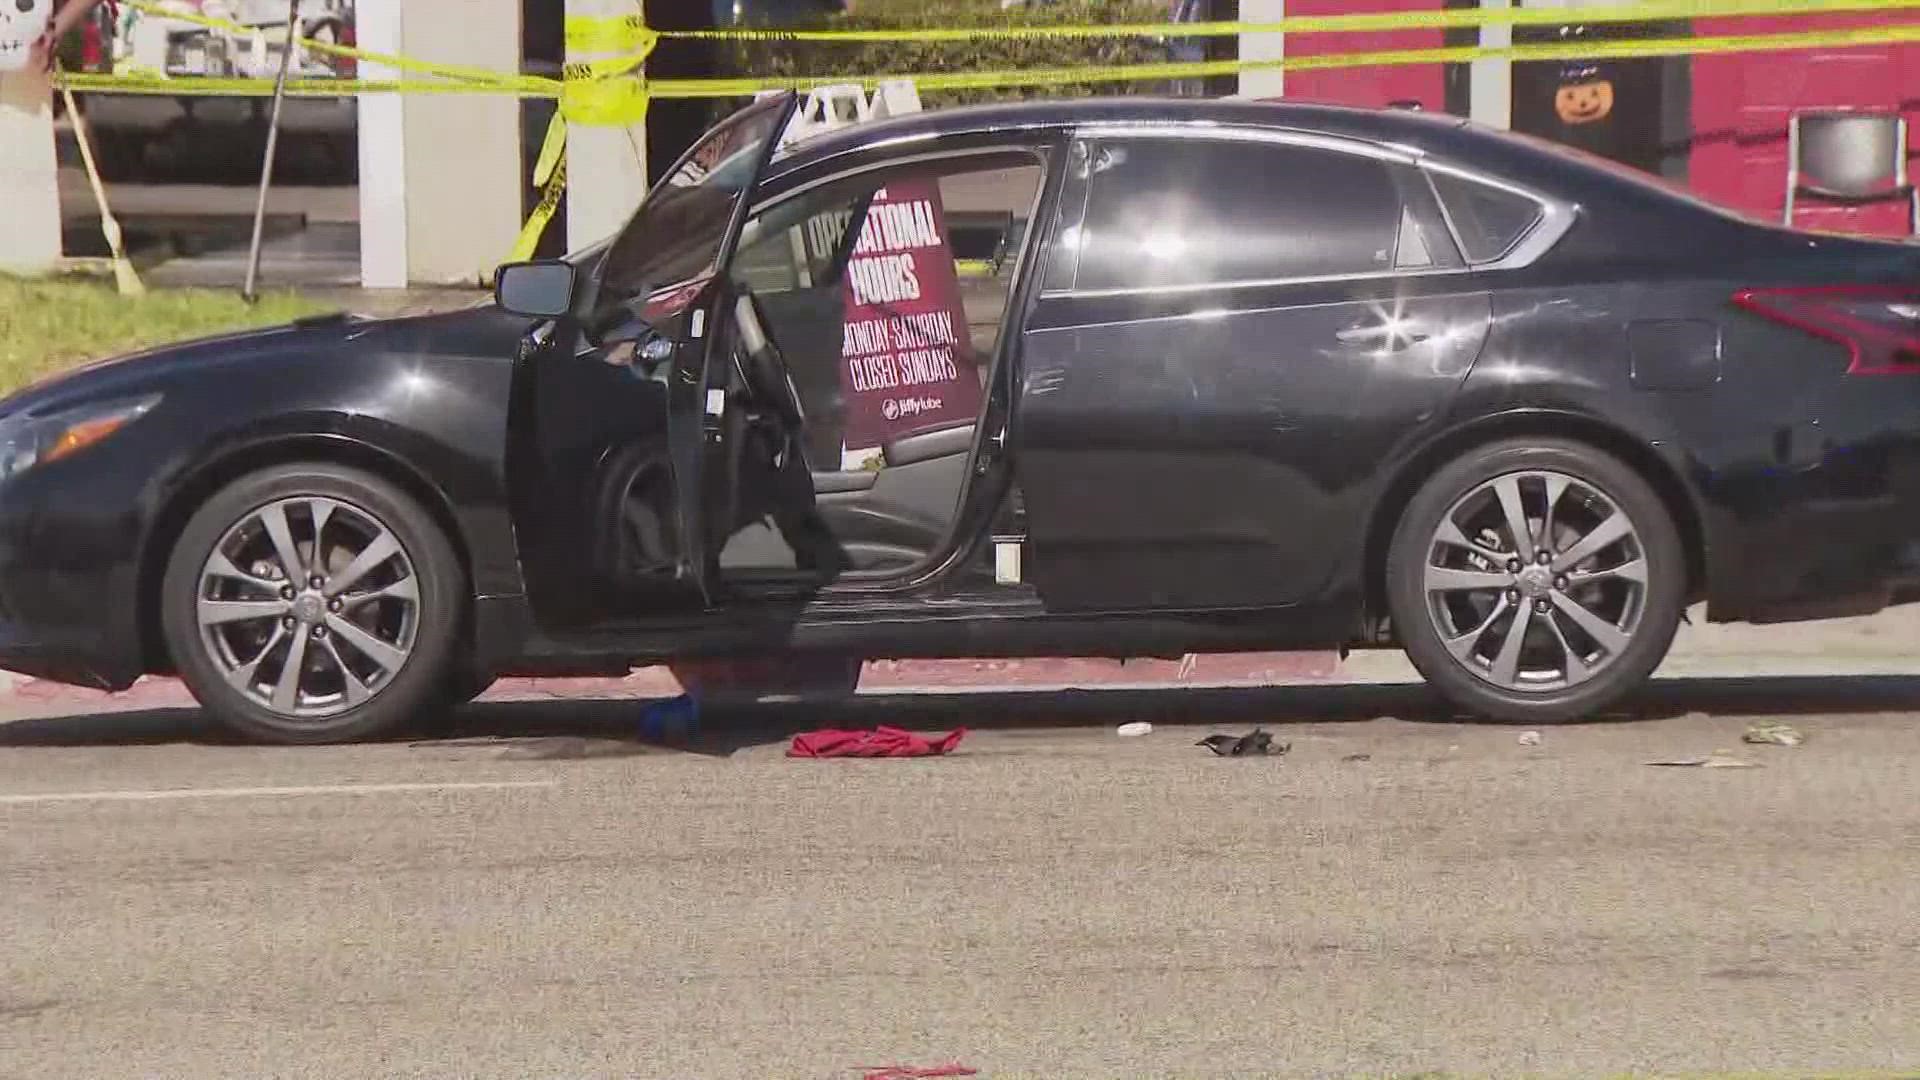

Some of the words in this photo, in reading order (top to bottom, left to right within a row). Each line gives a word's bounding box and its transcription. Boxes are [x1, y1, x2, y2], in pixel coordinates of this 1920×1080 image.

[807, 200, 942, 258] OPEATIONAL
[847, 252, 920, 305] HOURS
[849, 353, 899, 392] CLOSED
[898, 346, 958, 386] SUNDAYS
